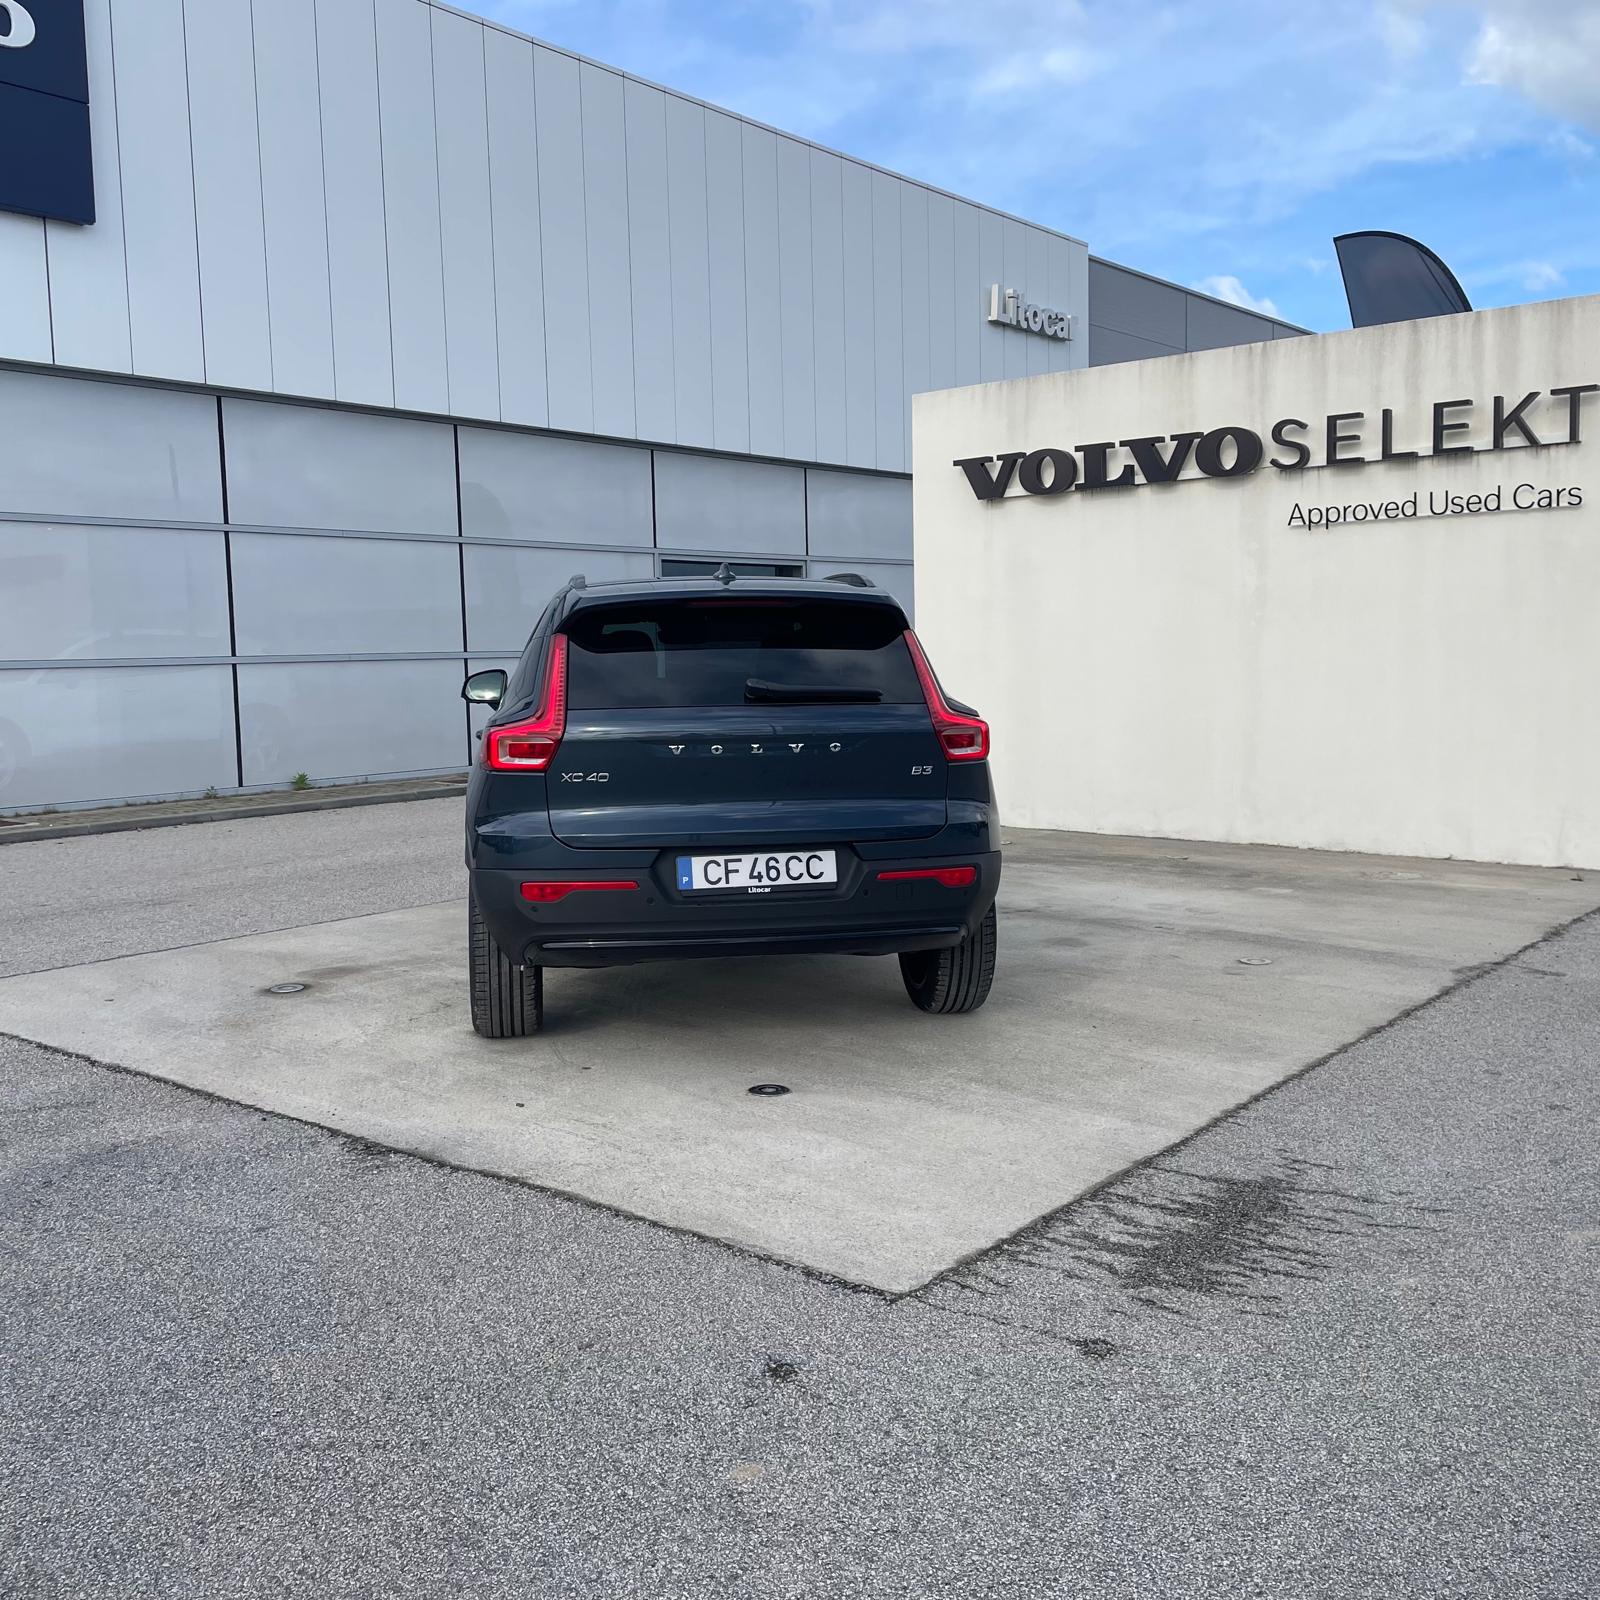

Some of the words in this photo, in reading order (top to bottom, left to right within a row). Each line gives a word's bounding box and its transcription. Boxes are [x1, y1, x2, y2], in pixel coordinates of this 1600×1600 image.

[1287, 492, 1418, 531] Approved
[1429, 485, 1502, 516] Used
[1513, 483, 1584, 510] Cars
[668, 742, 842, 755] VOLVO
[911, 765, 933, 776] B3
[682, 876, 689, 885] P
[748, 886, 772, 894] Litocar
